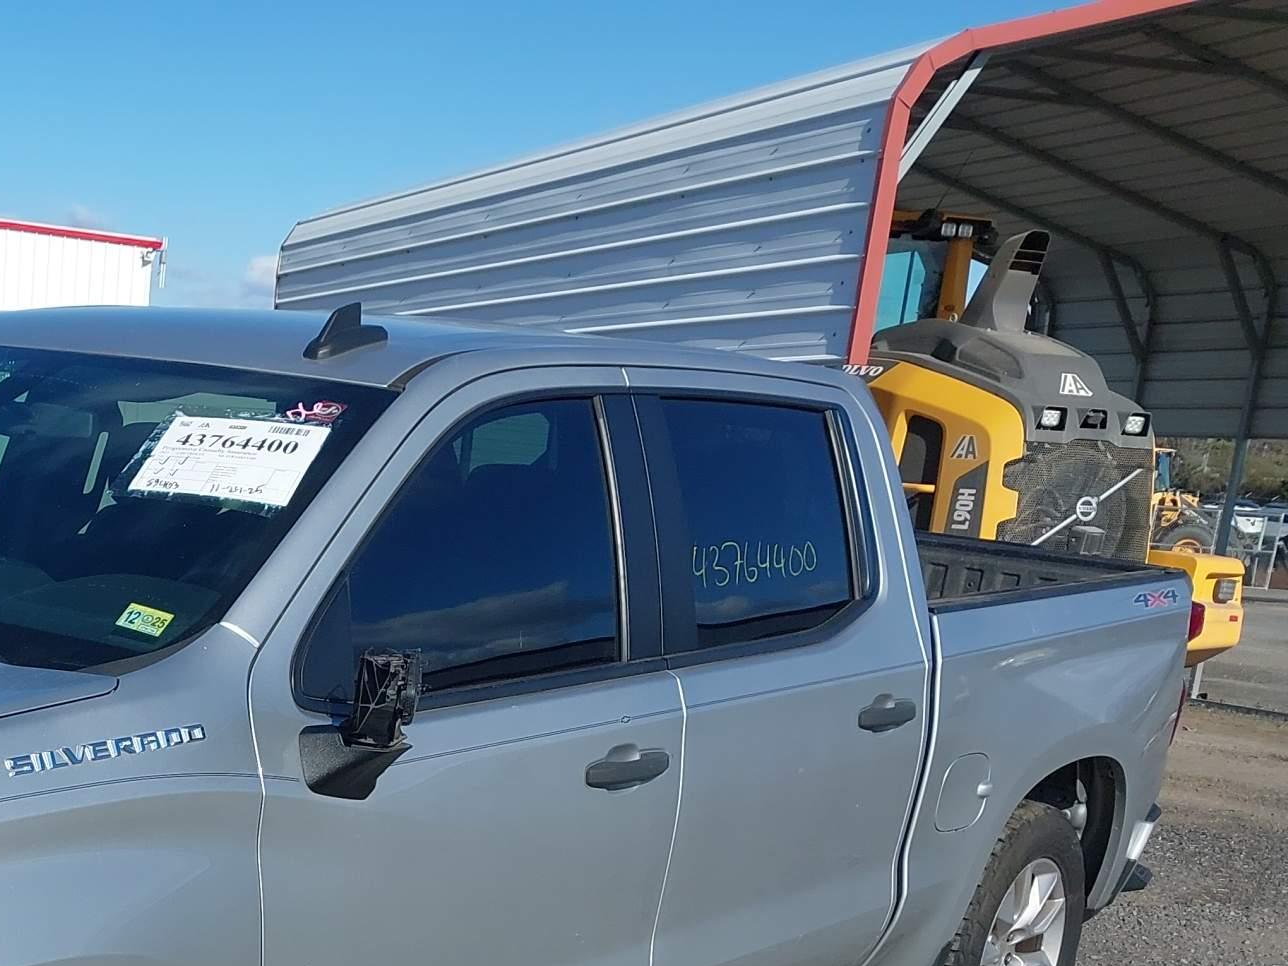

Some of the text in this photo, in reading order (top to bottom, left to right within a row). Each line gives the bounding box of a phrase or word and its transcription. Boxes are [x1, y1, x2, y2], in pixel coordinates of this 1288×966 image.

[841, 364, 884, 377] OLVO
[175, 432, 299, 455] 43764400
[951, 487, 977, 530] L90H
[692, 540, 817, 588] 43764400
[123, 609, 142, 625] 12
[151, 616, 169, 629] 25
[3, 723, 206, 778] SILVERADO
